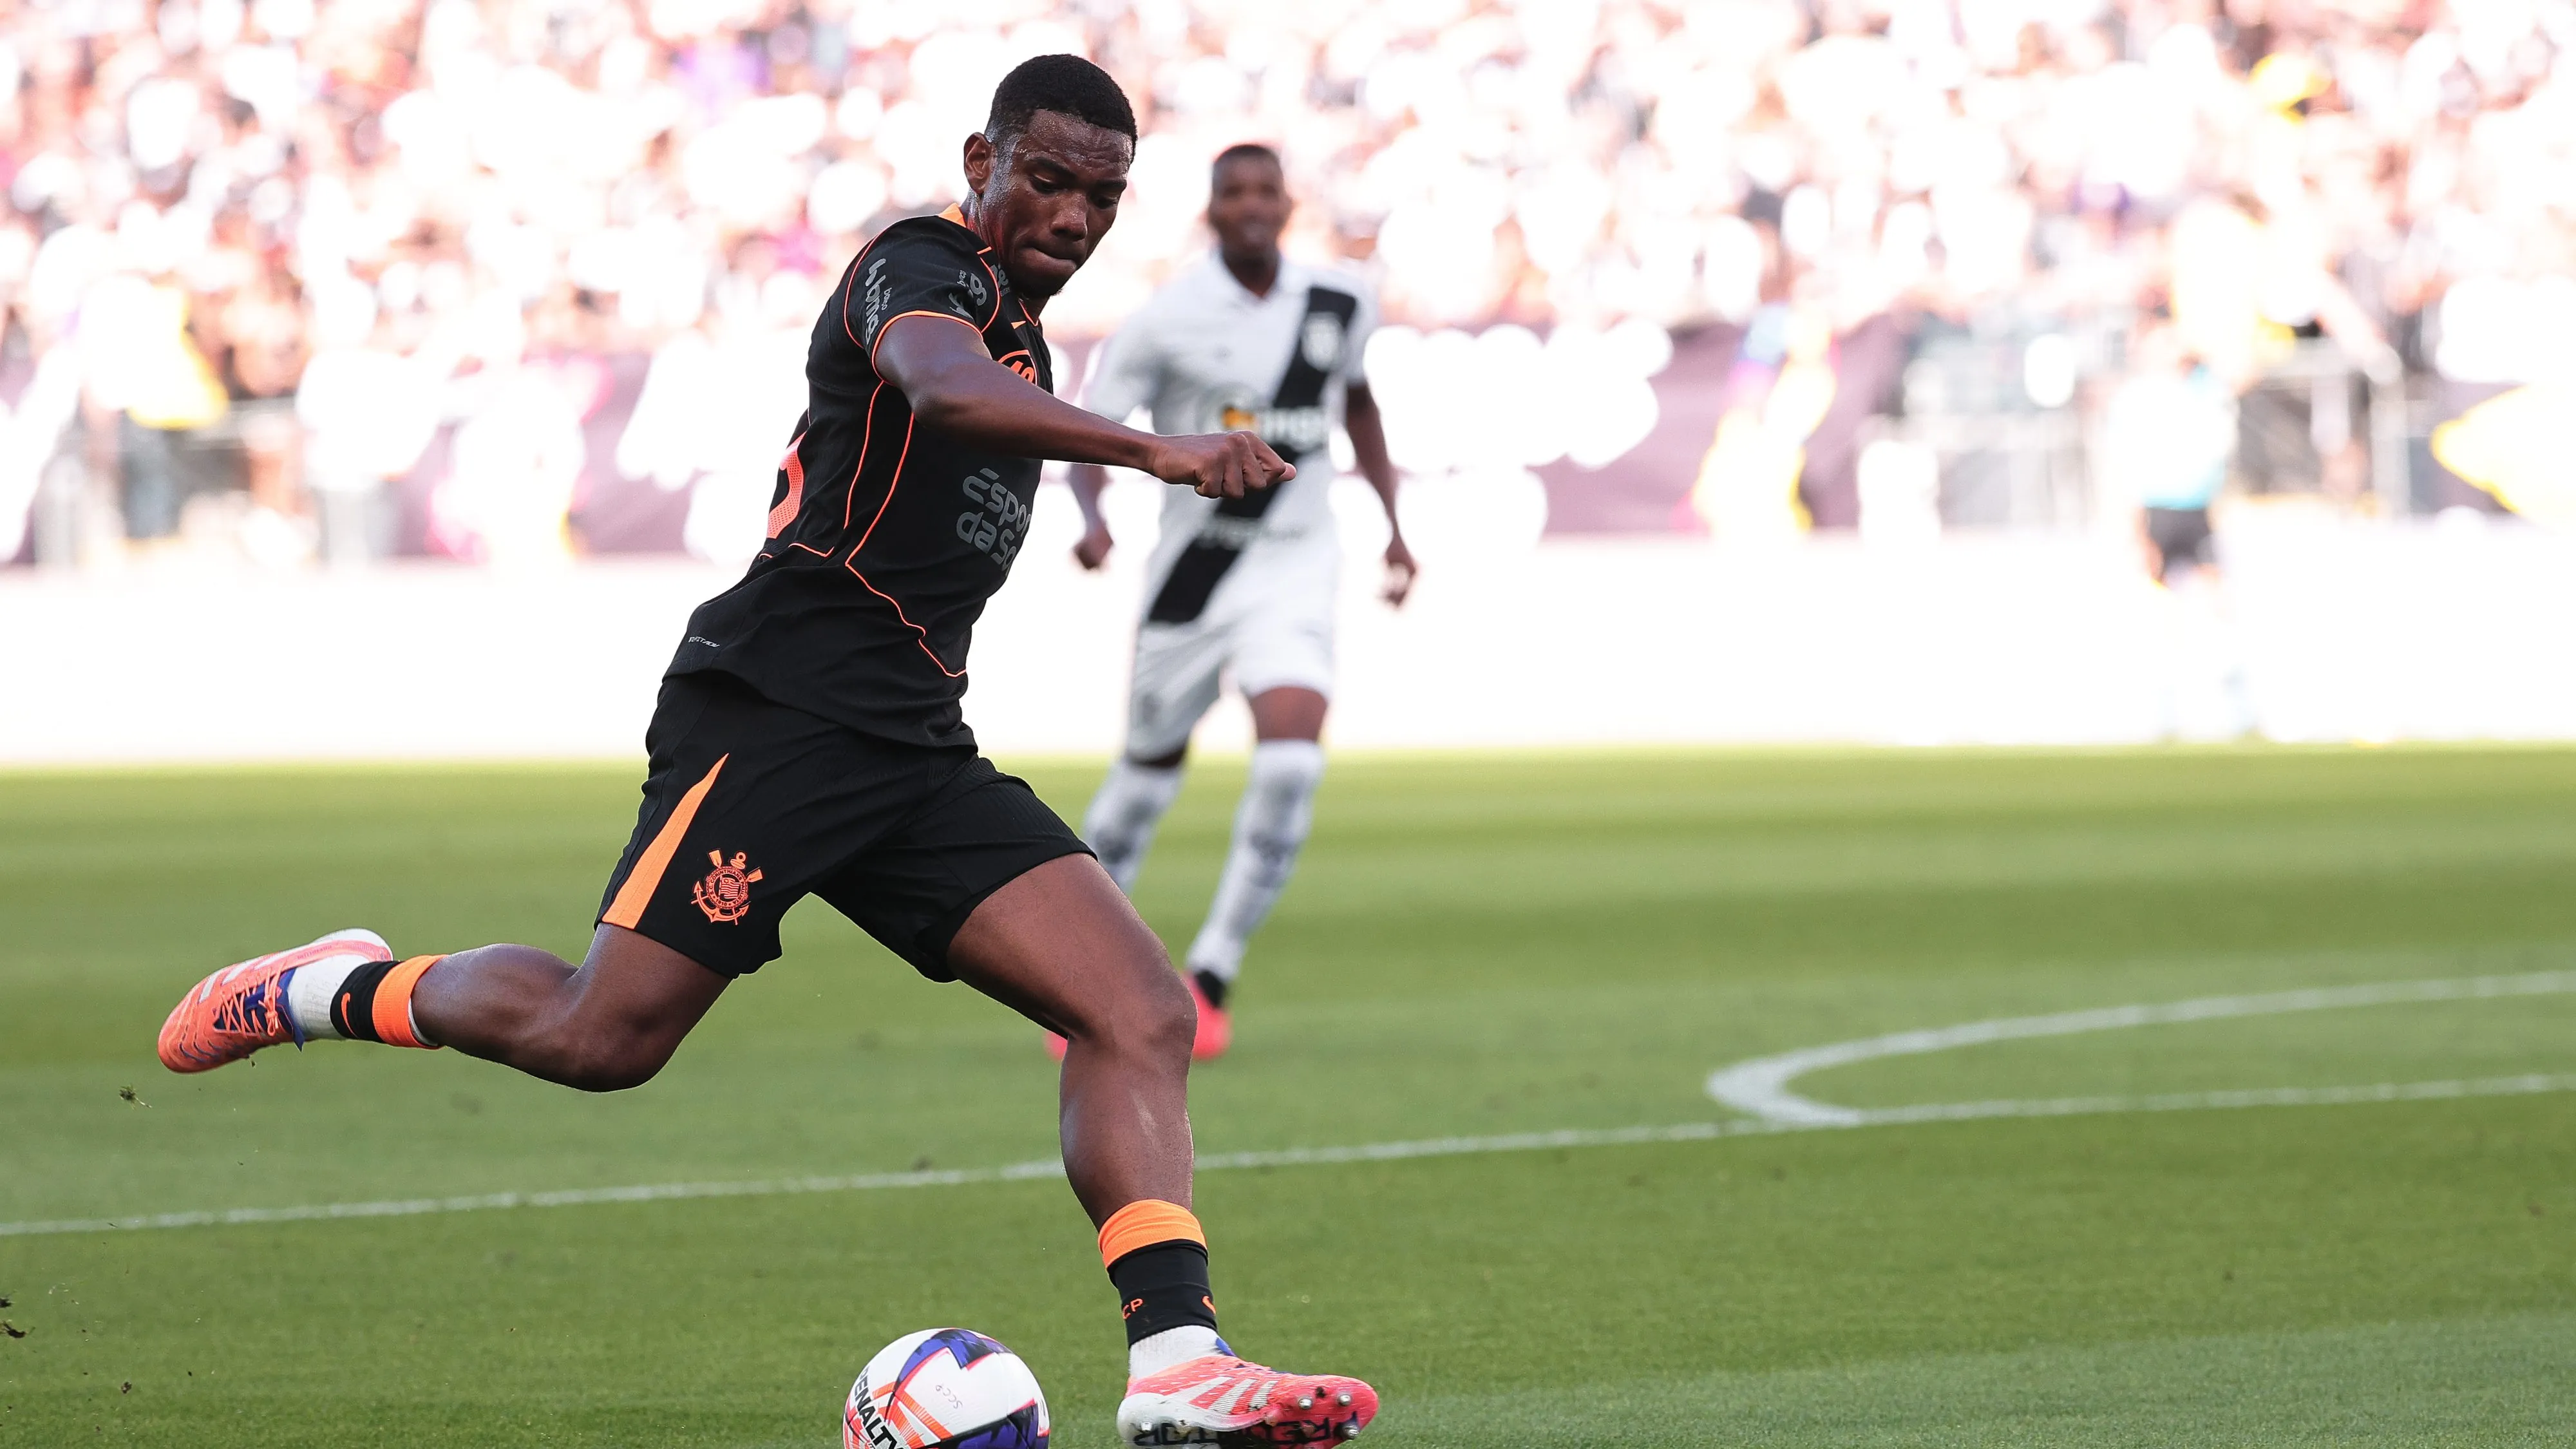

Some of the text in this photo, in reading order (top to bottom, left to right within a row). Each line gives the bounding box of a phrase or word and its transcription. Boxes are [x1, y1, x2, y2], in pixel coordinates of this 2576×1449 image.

[956, 511, 997, 554] da
[710, 869, 743, 884] CORINTHIANS
[732, 881, 745, 904] PAULISTA
